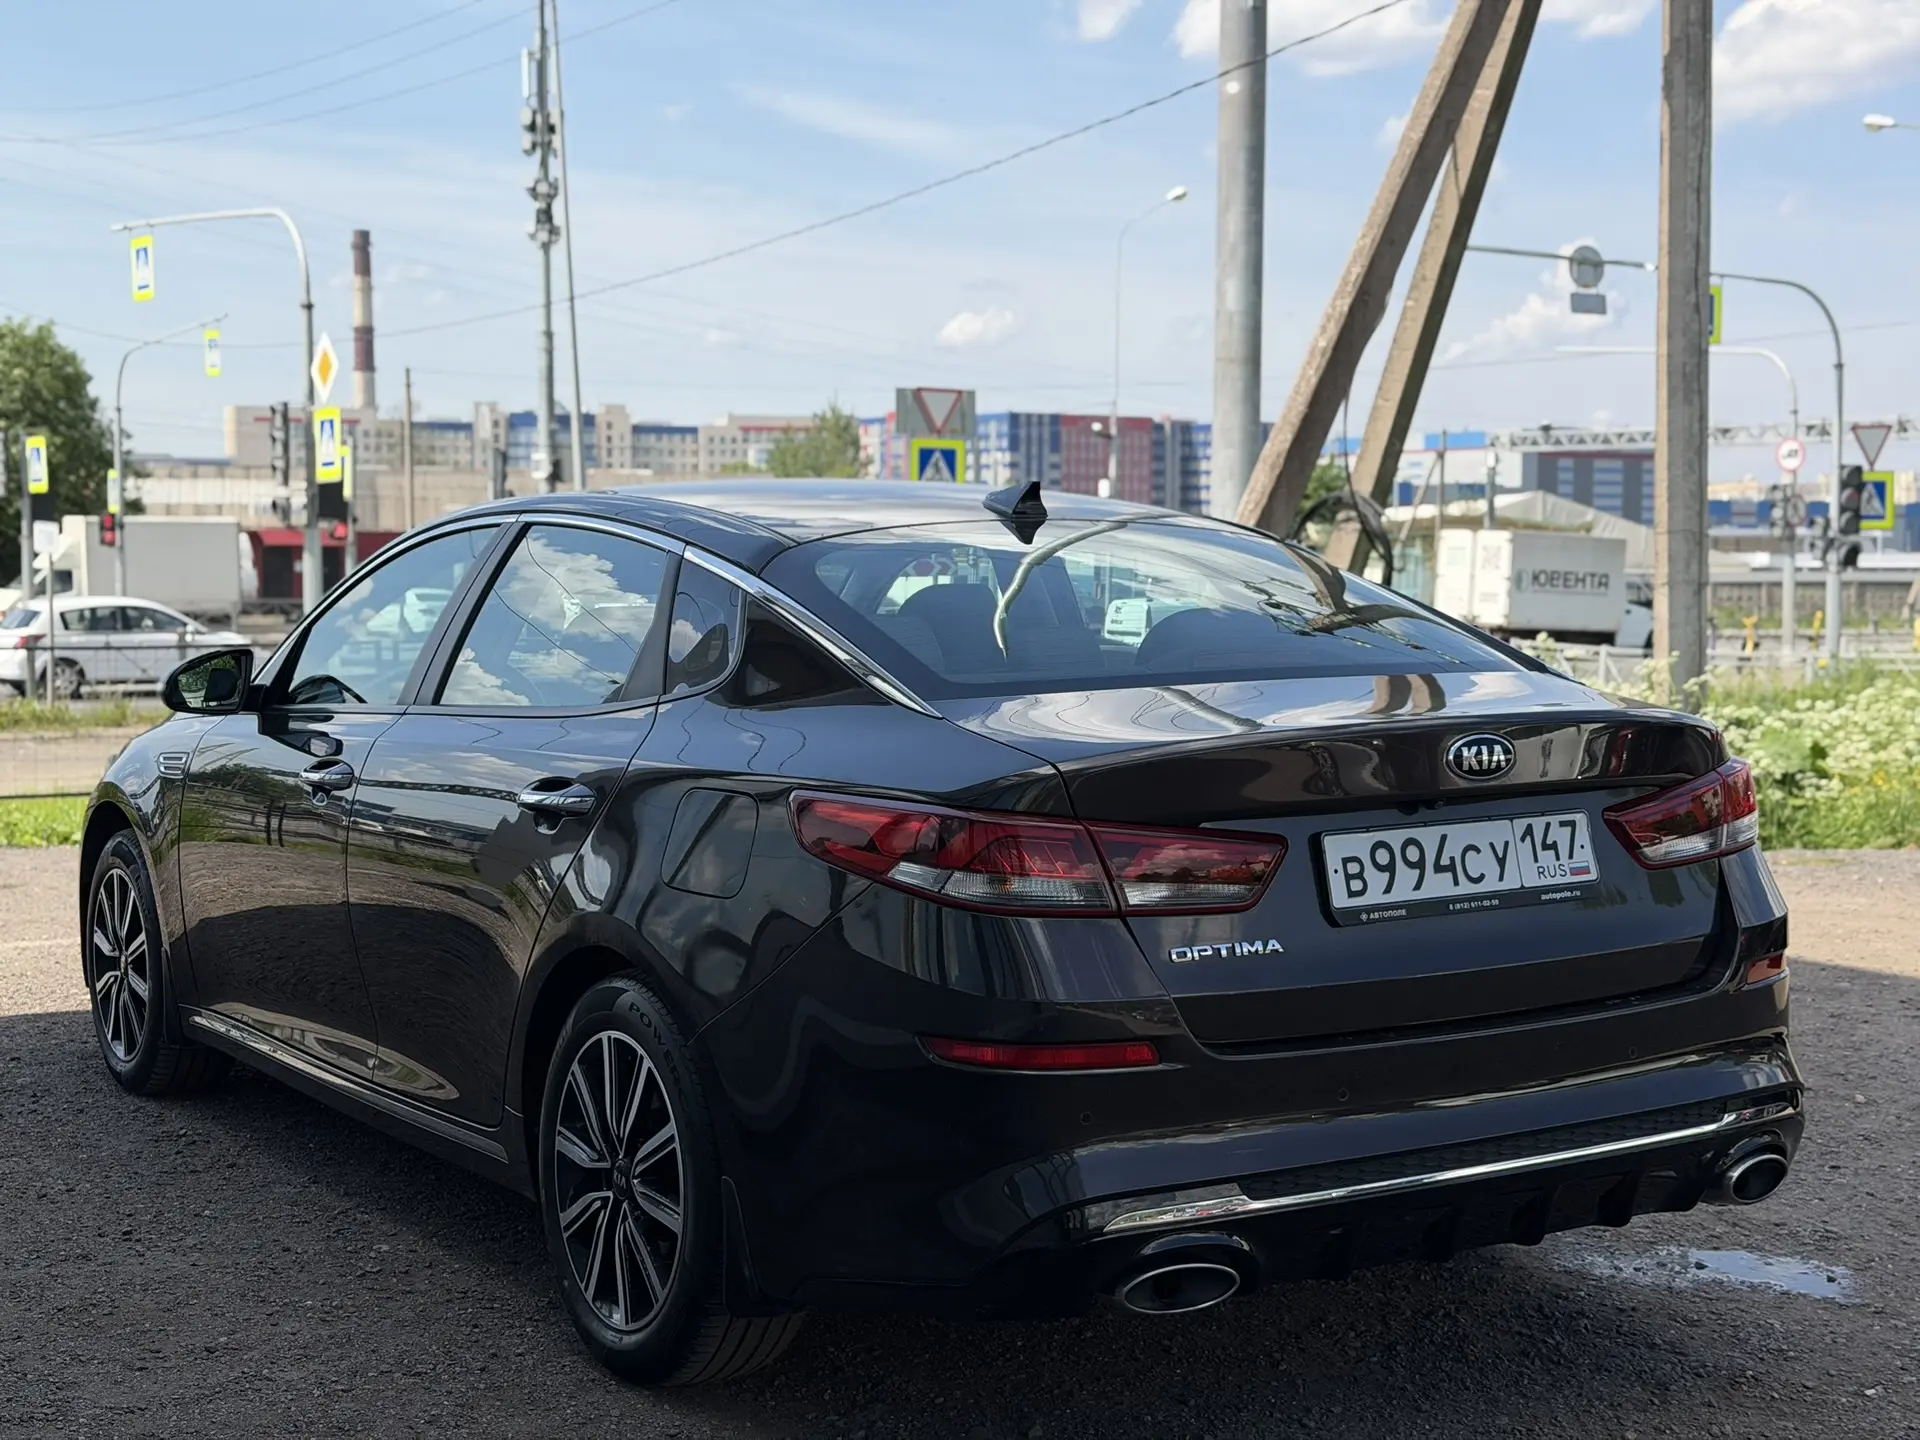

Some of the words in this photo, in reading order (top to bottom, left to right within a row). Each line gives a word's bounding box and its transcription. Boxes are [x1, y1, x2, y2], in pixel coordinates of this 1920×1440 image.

[1531, 568, 1610, 591] ЮВЕНТА
[1460, 744, 1507, 771] KIA
[1341, 833, 1510, 899] В994СУ
[1519, 819, 1577, 864] 147
[1537, 863, 1568, 880] RUS
[1540, 889, 1581, 901] autopole.ru
[1169, 938, 1285, 963] OPTIMA
